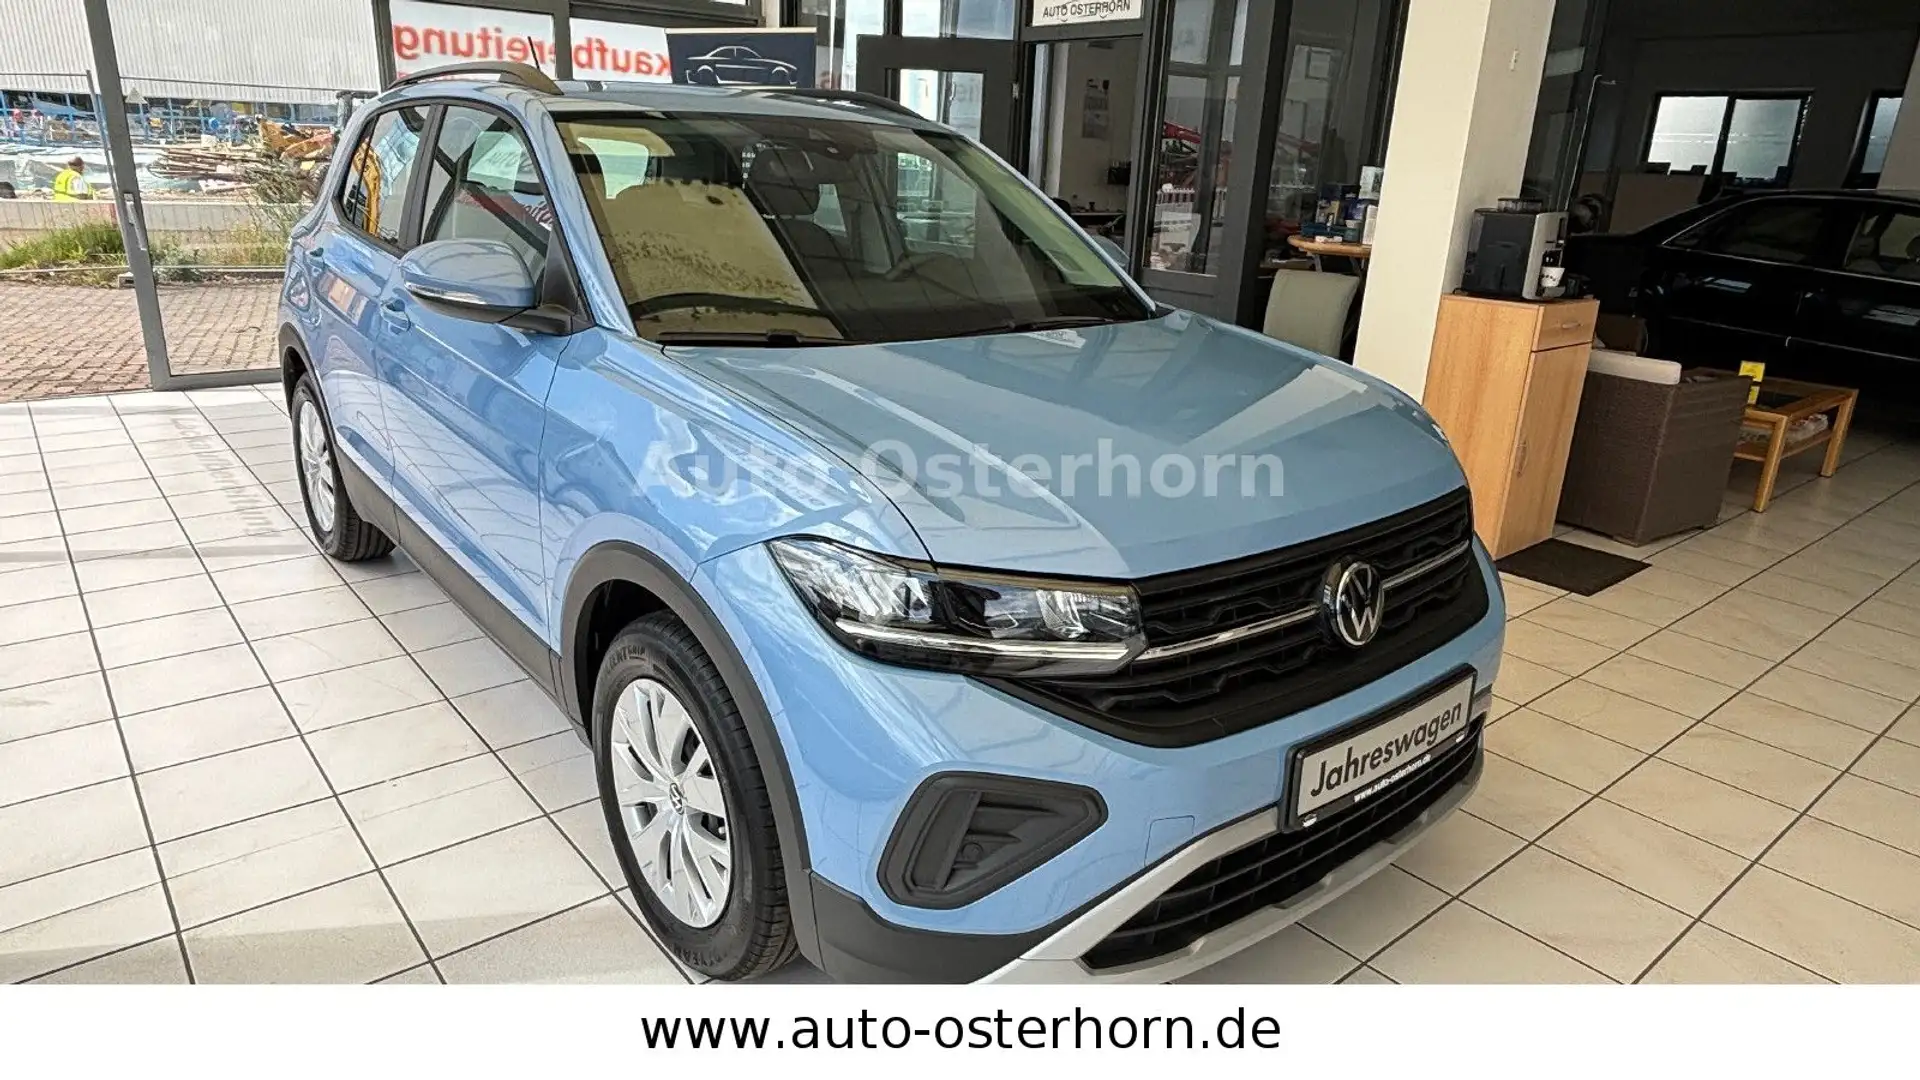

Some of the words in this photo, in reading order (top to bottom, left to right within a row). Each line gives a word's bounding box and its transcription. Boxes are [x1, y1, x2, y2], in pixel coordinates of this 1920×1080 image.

[1043, 4, 1068, 18] AUTO
[1070, 0, 1130, 16] OSTERHORN
[1310, 702, 1462, 797] Jahreswagen
